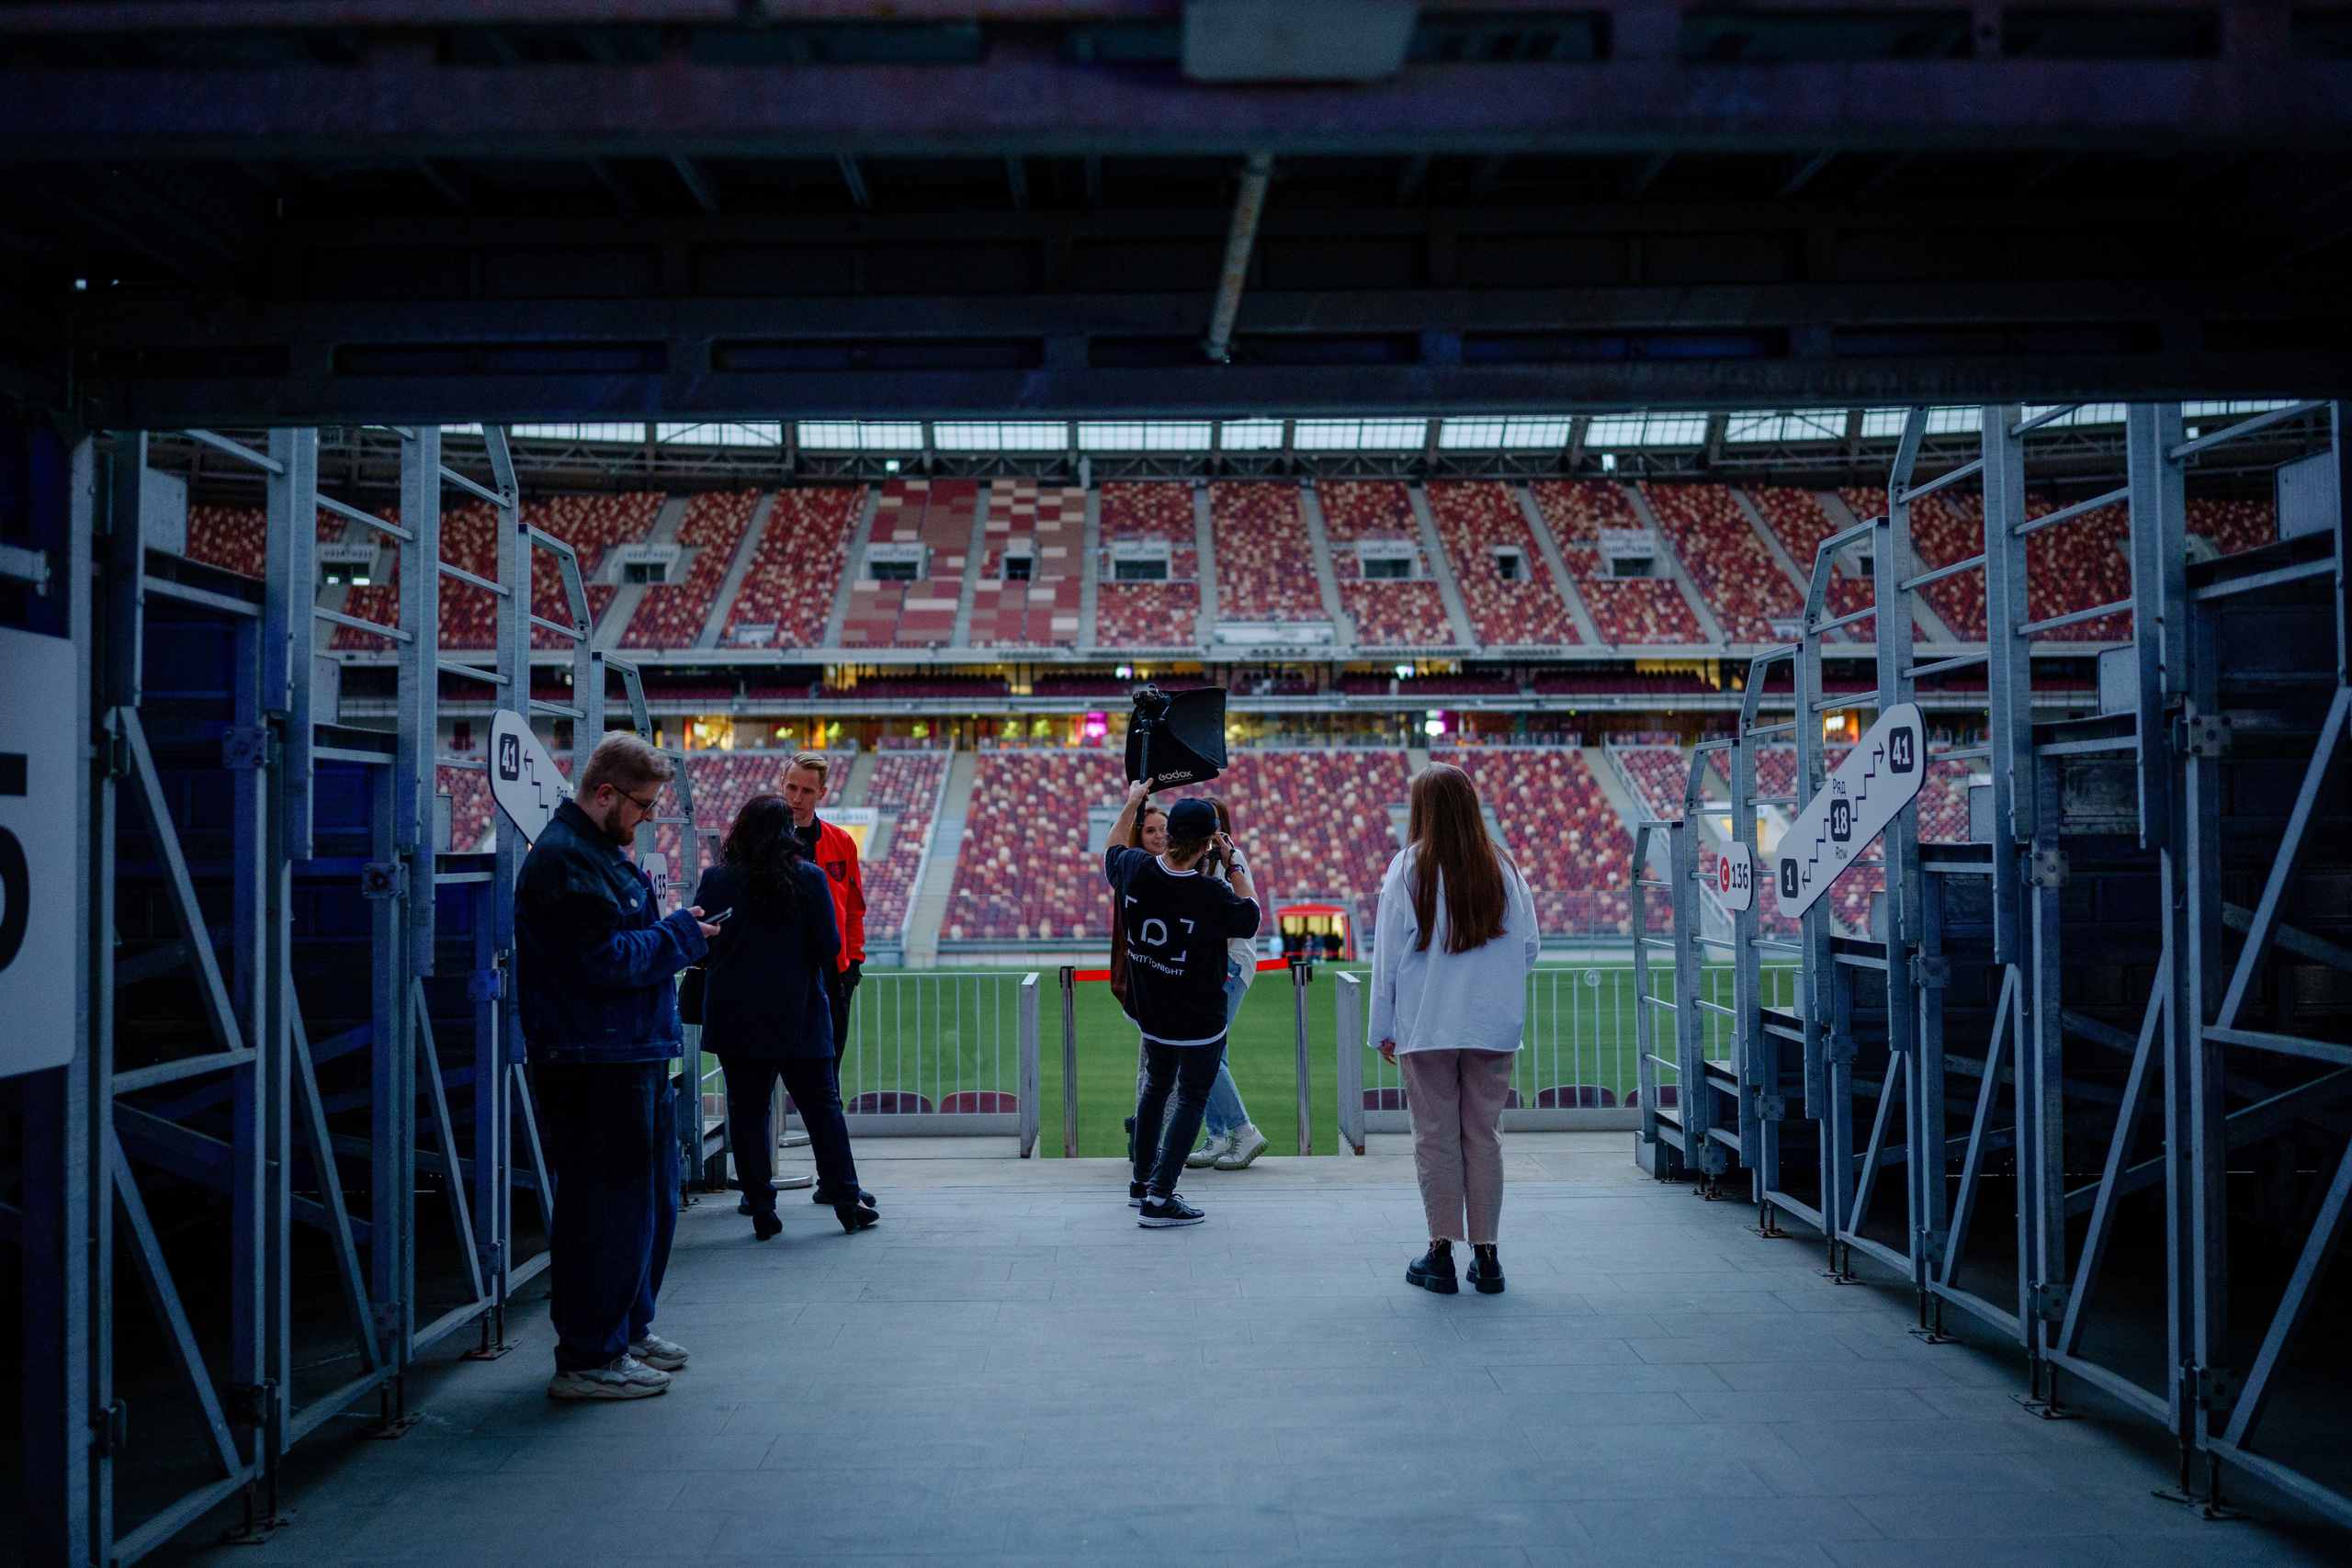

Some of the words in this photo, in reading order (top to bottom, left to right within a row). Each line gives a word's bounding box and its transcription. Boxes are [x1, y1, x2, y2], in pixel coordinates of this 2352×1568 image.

[502, 742, 517, 773] 41
[1893, 734, 1910, 765] 41
[1158, 769, 1193, 781] Godox
[1832, 778, 1847, 797] Ряд
[1833, 807, 1849, 835] 18
[1836, 846, 1849, 860] Row
[653, 874, 667, 900] 135
[1732, 863, 1748, 890] 136
[1786, 865, 1793, 891] 1
